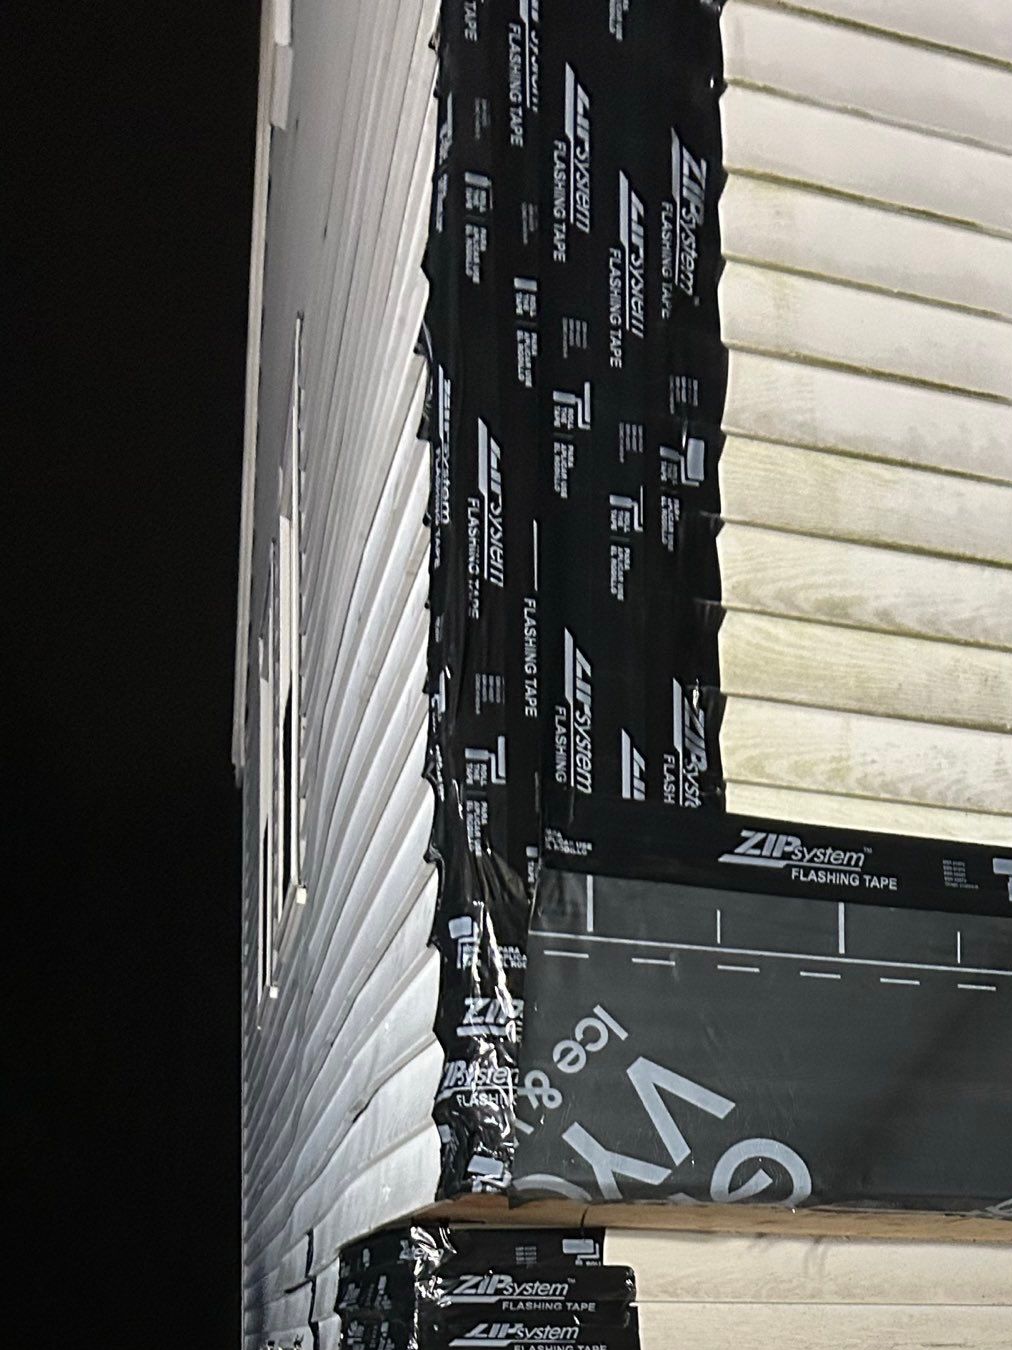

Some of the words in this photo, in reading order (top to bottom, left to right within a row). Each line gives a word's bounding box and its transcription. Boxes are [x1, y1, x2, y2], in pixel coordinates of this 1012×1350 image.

[509, 24, 523, 102] FLASHING
[510, 106, 523, 147] TAPE
[553, 140, 567, 218] FLASHING
[553, 222, 566, 262] TAPE
[661, 202, 674, 278] FLASHING
[609, 248, 622, 326] FLASHING
[610, 329, 622, 368] TAPE
[524, 598, 537, 673] FLASHING
[525, 678, 538, 717] TAPE
[555, 705, 567, 783] FLASHING
[791, 867, 860, 888] FLASHING
[864, 875, 898, 892] TAPE
[552, 1003, 629, 1074] Ice
[502, 1301, 562, 1312] FLASHING
[566, 1302, 597, 1312] TAPE
